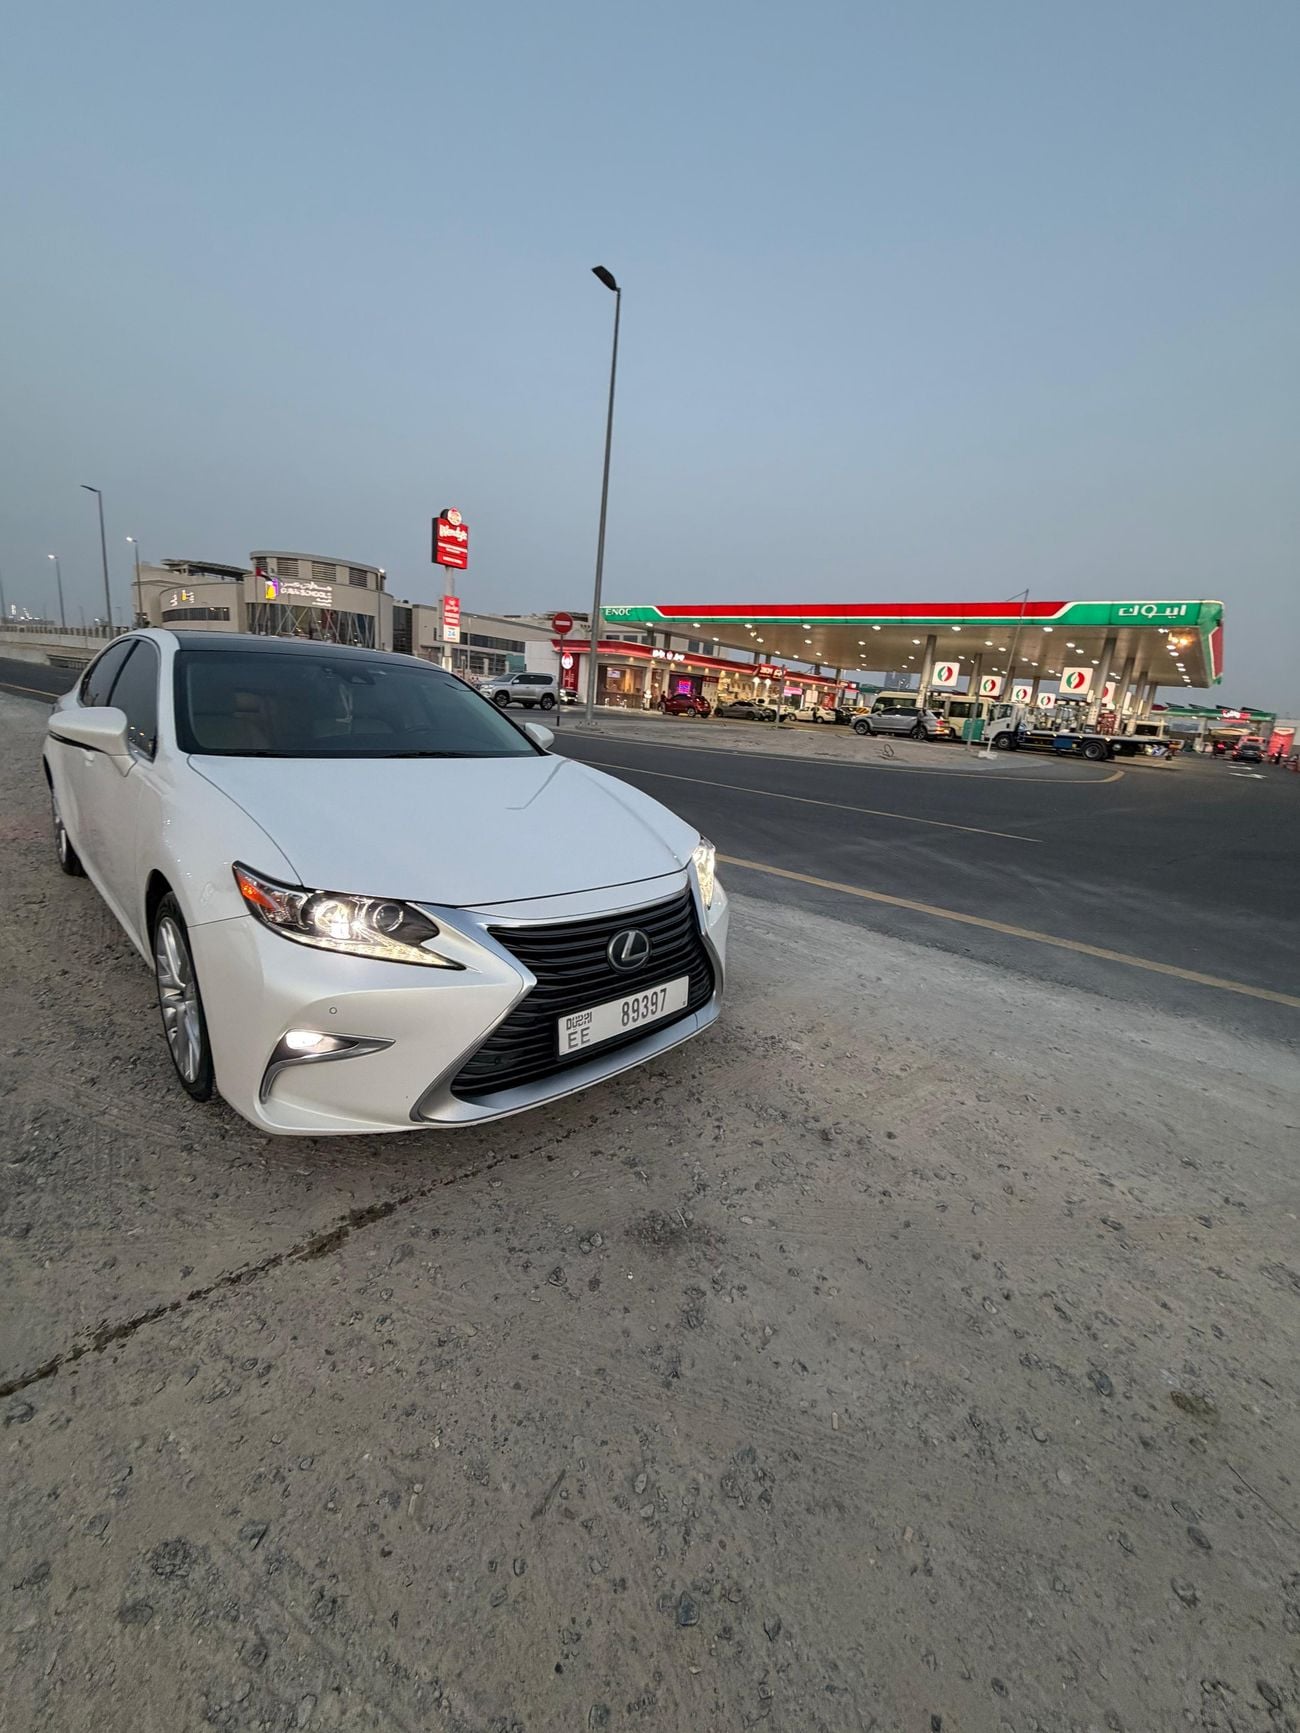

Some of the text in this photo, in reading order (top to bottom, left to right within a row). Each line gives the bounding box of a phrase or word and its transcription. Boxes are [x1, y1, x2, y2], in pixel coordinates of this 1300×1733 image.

[605, 608, 631, 616] ENOC
[621, 987, 667, 1027] 89397
[567, 1026, 591, 1049] EE
